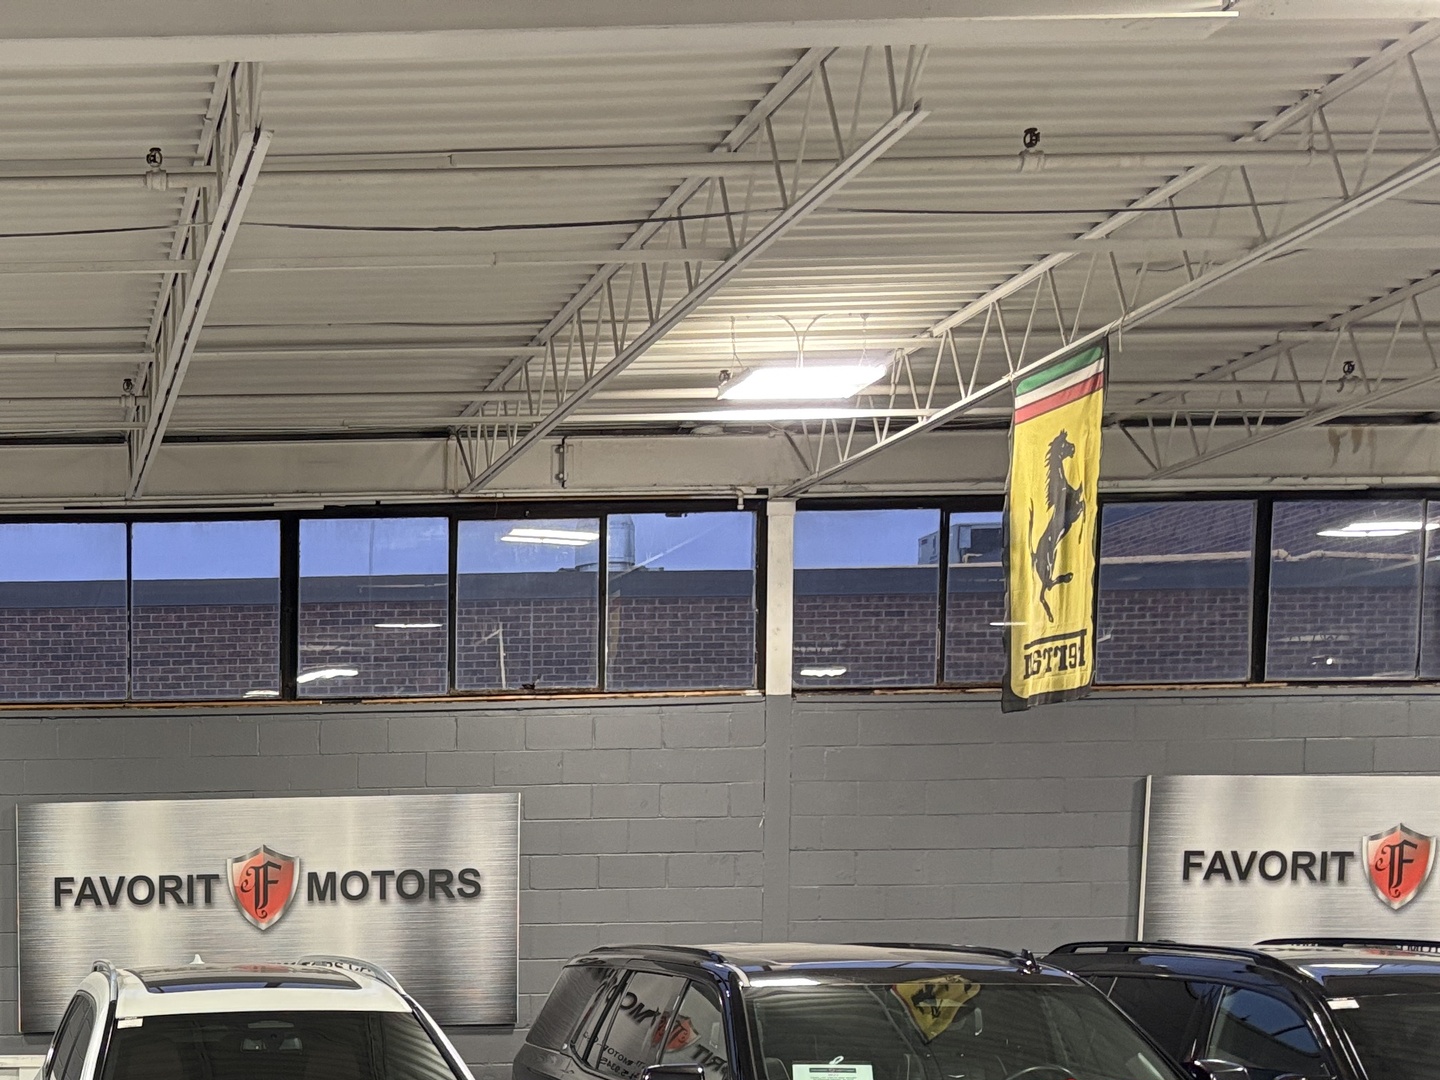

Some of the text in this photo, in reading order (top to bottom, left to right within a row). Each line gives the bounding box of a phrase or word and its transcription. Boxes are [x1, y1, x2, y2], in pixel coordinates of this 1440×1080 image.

[1182, 850, 1355, 882] FAVORIT
[54, 873, 220, 907] FAVORIT
[307, 867, 482, 901] MOTORS
